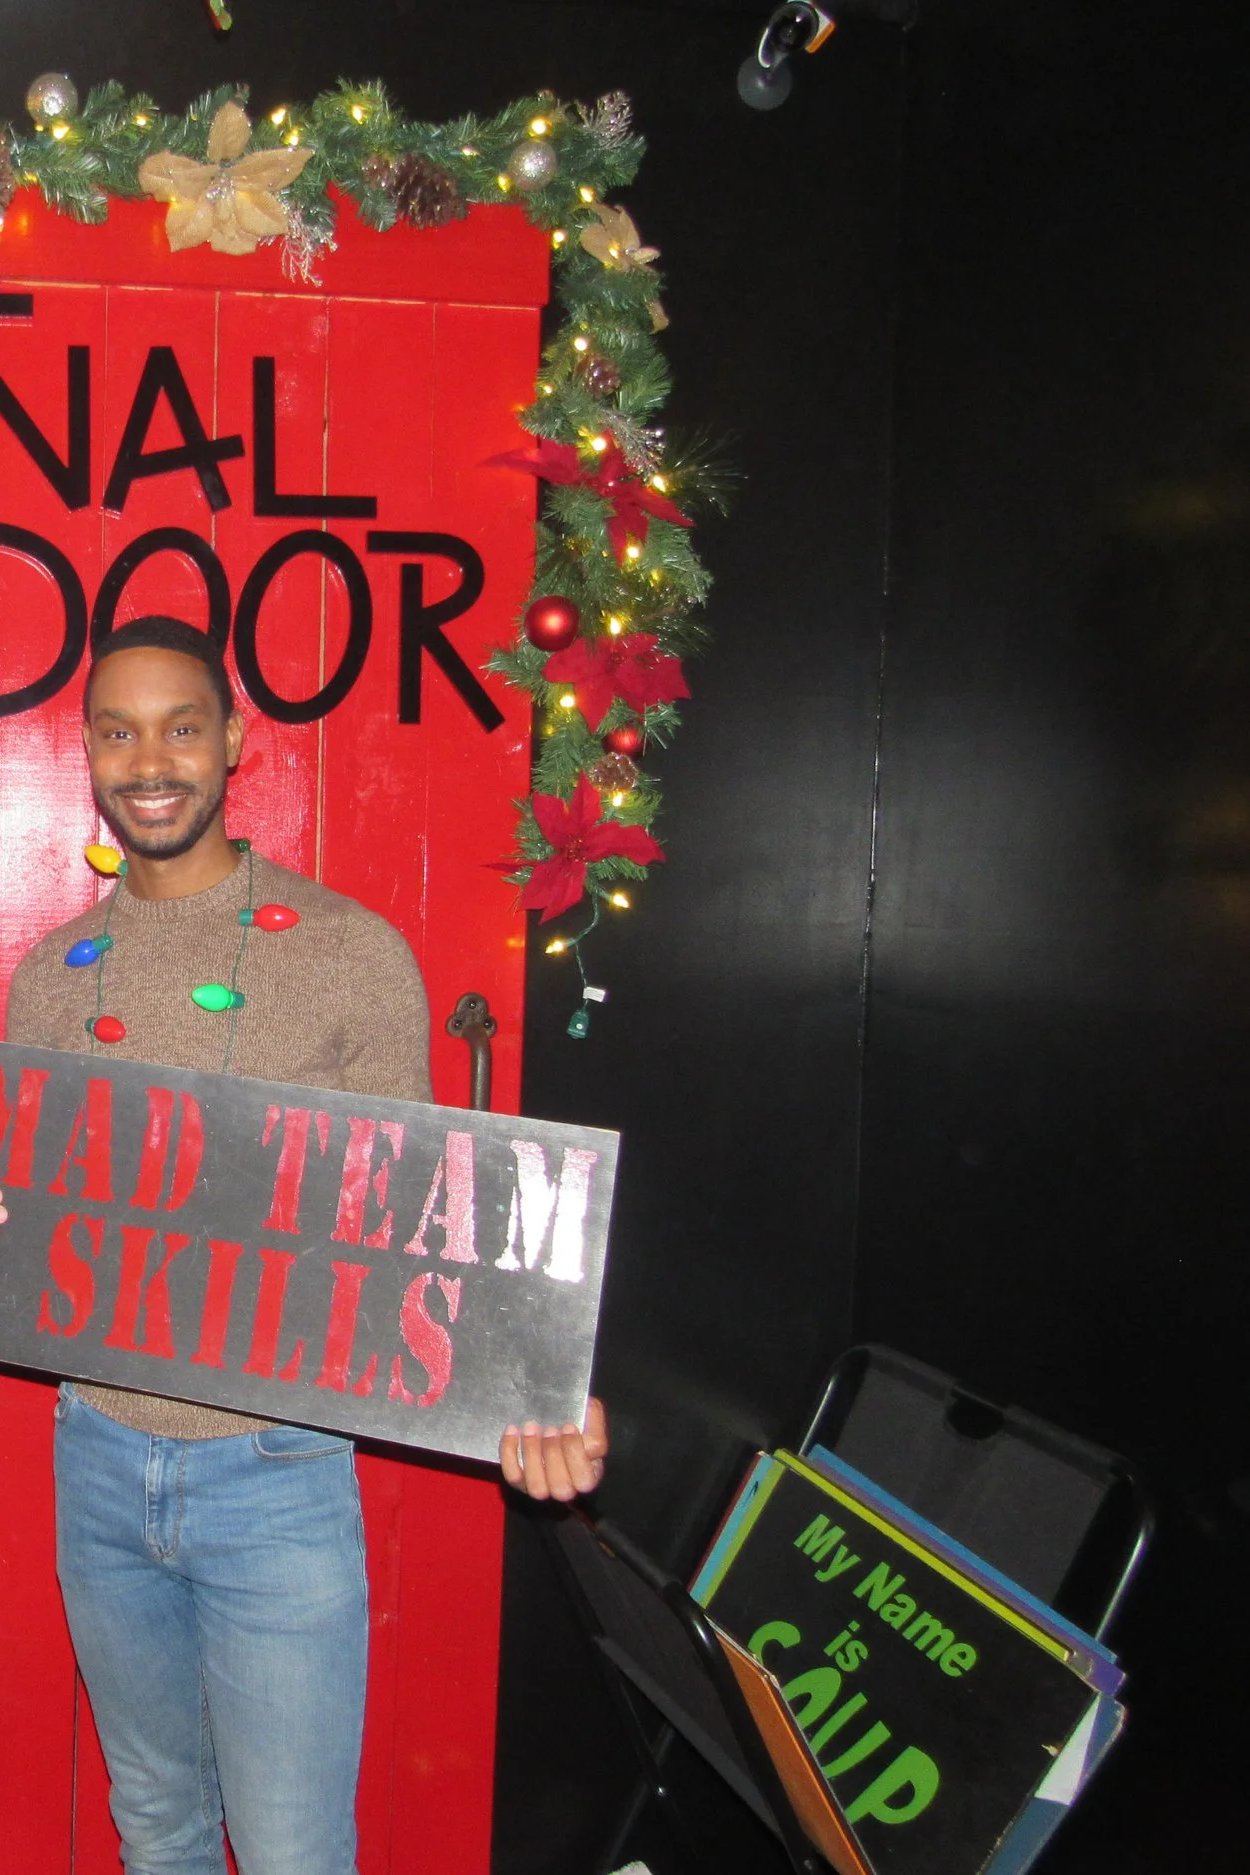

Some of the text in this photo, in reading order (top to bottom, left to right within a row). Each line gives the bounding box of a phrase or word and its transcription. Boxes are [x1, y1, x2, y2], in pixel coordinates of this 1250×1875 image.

[261, 1103, 599, 1283] TEAM
[35, 1211, 463, 1409] SKILLS
[793, 1513, 980, 1678] My Name
[822, 1620, 870, 1672] is
